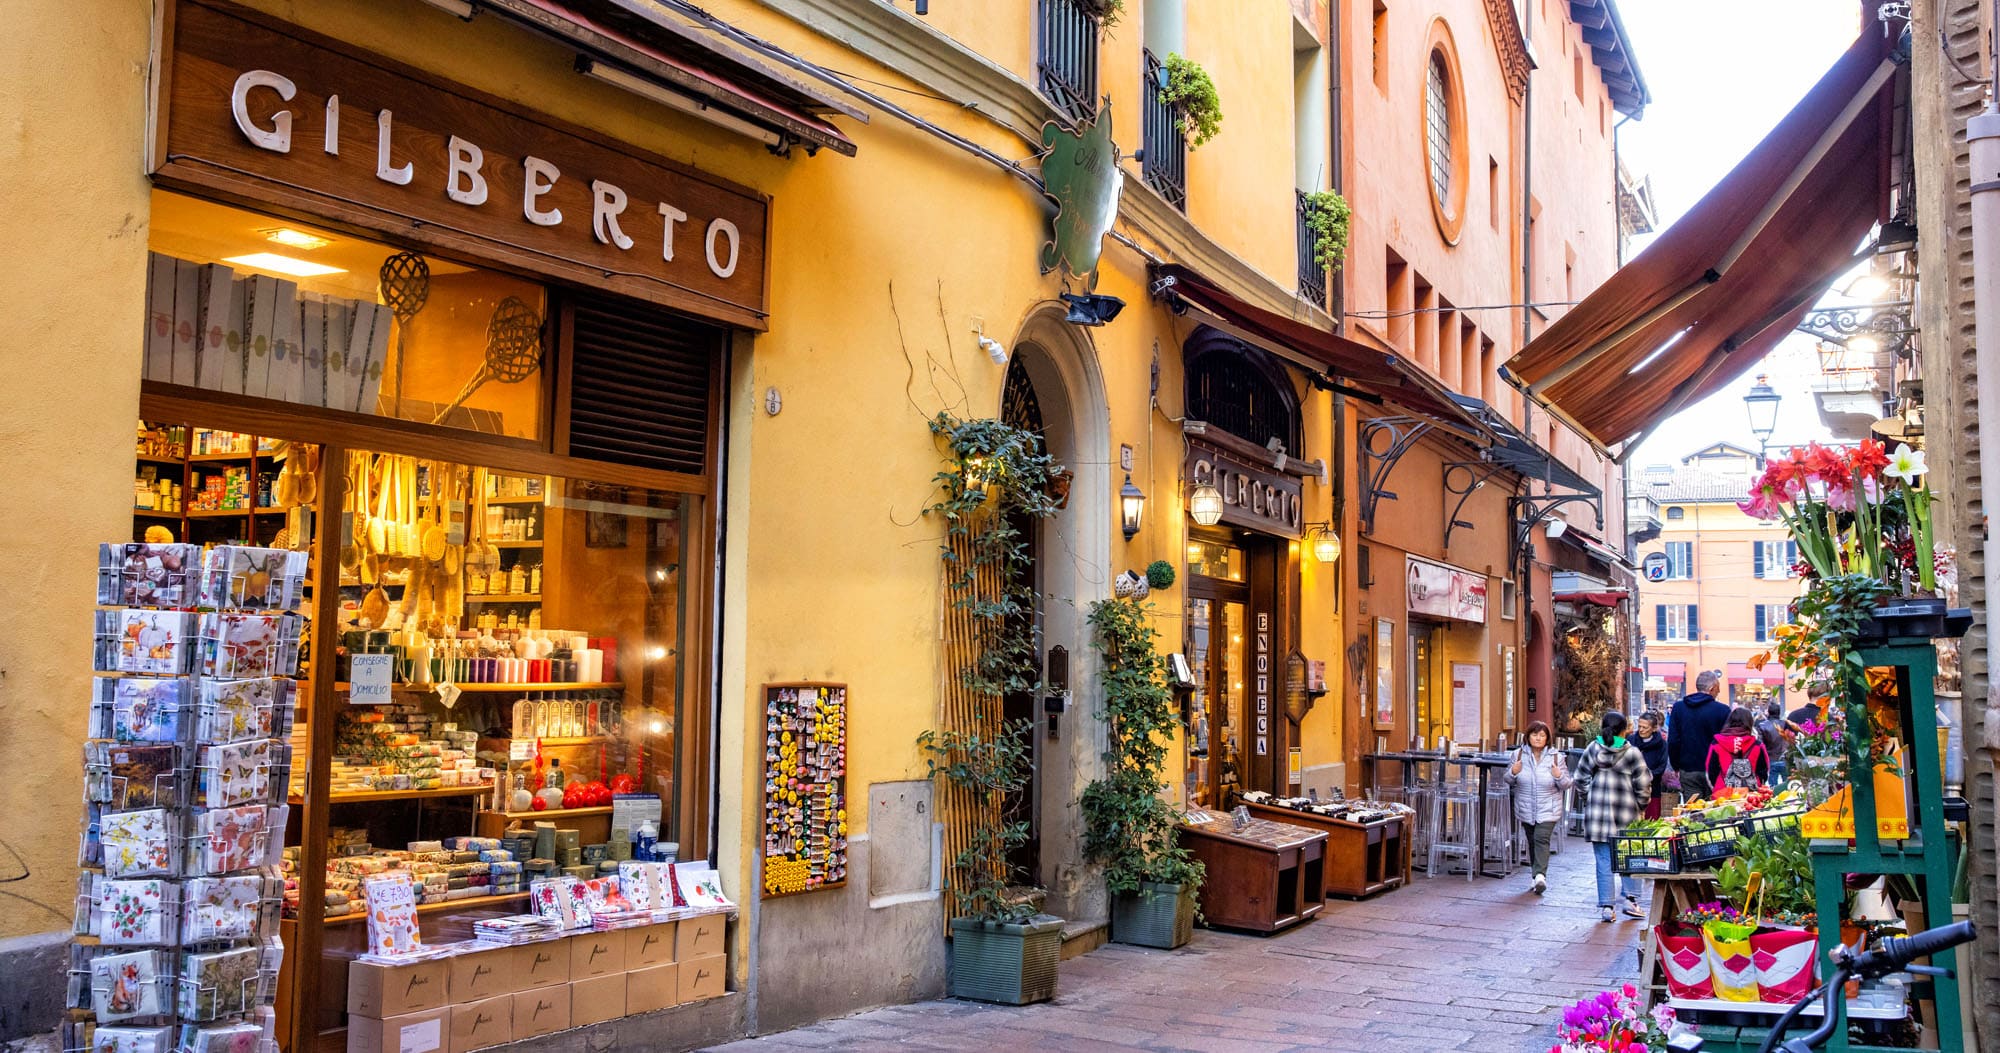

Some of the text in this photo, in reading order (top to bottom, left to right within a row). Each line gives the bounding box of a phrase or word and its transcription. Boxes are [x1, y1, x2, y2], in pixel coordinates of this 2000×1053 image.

[231, 69, 740, 278] GILBERTO
[771, 389, 776, 401] 5
[353, 656, 389, 666] CONSEGNE
[366, 667, 372, 676] A
[351, 682, 388, 698] DOMICILIO
[1257, 614, 1267, 754] ENOTECA
